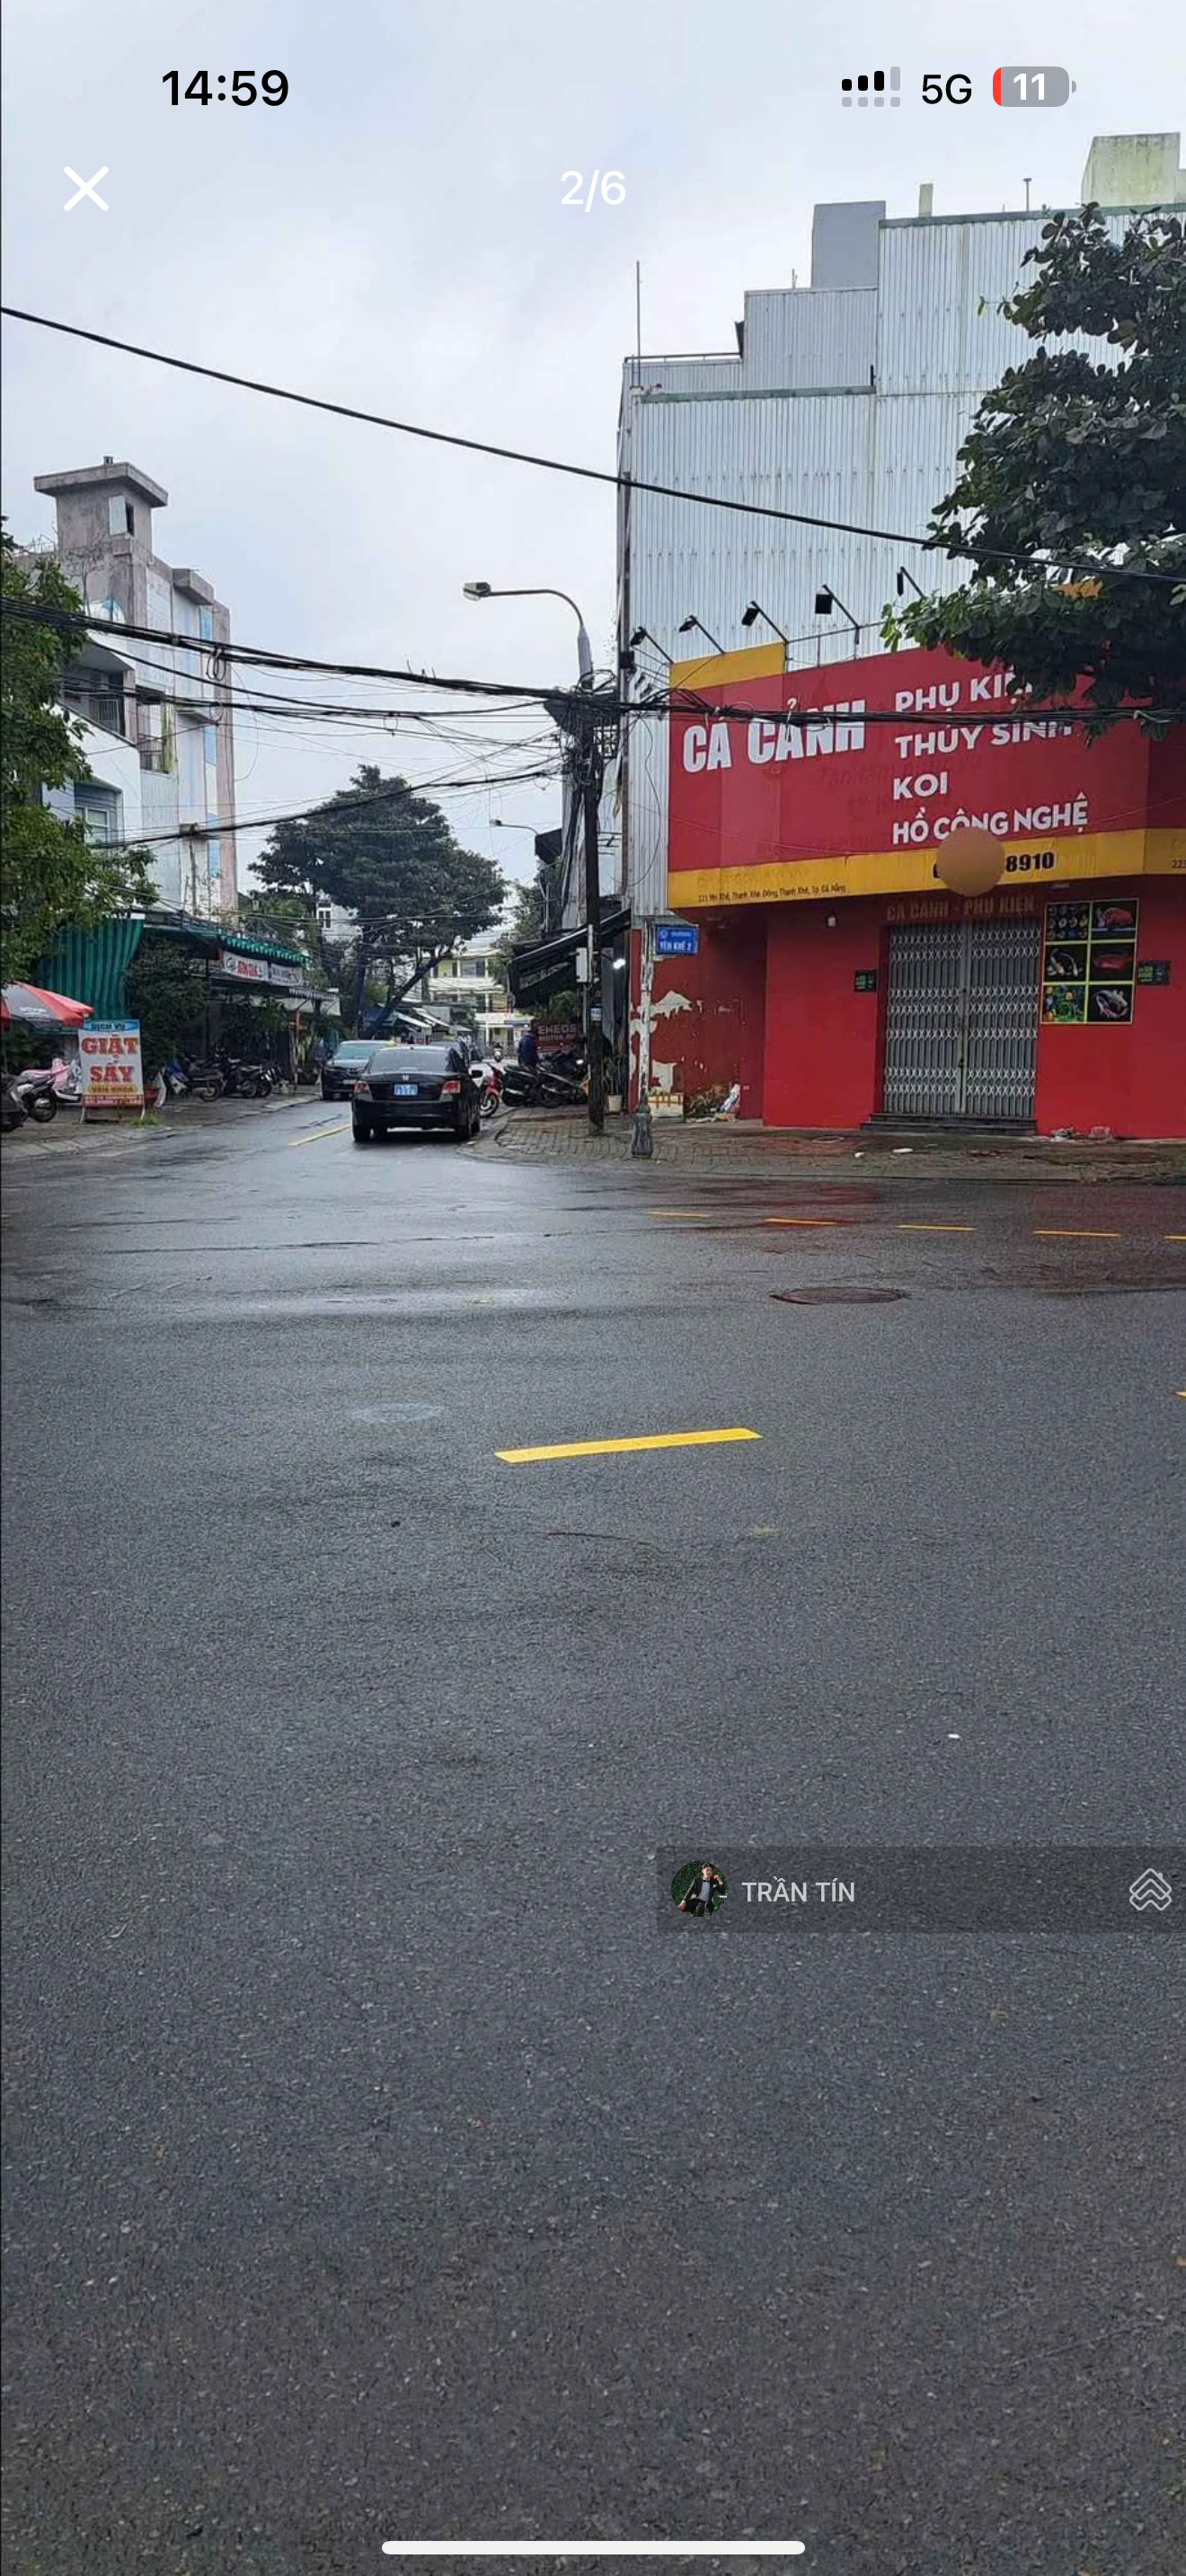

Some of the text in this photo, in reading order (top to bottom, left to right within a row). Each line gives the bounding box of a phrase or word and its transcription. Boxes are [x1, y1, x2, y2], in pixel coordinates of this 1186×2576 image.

[895, 681, 960, 712] PHỤ
[747, 697, 866, 764] CẢNH
[893, 772, 948, 801] KOI
[892, 807, 930, 845] HỒ
[1013, 791, 1089, 834] NGHỆ
